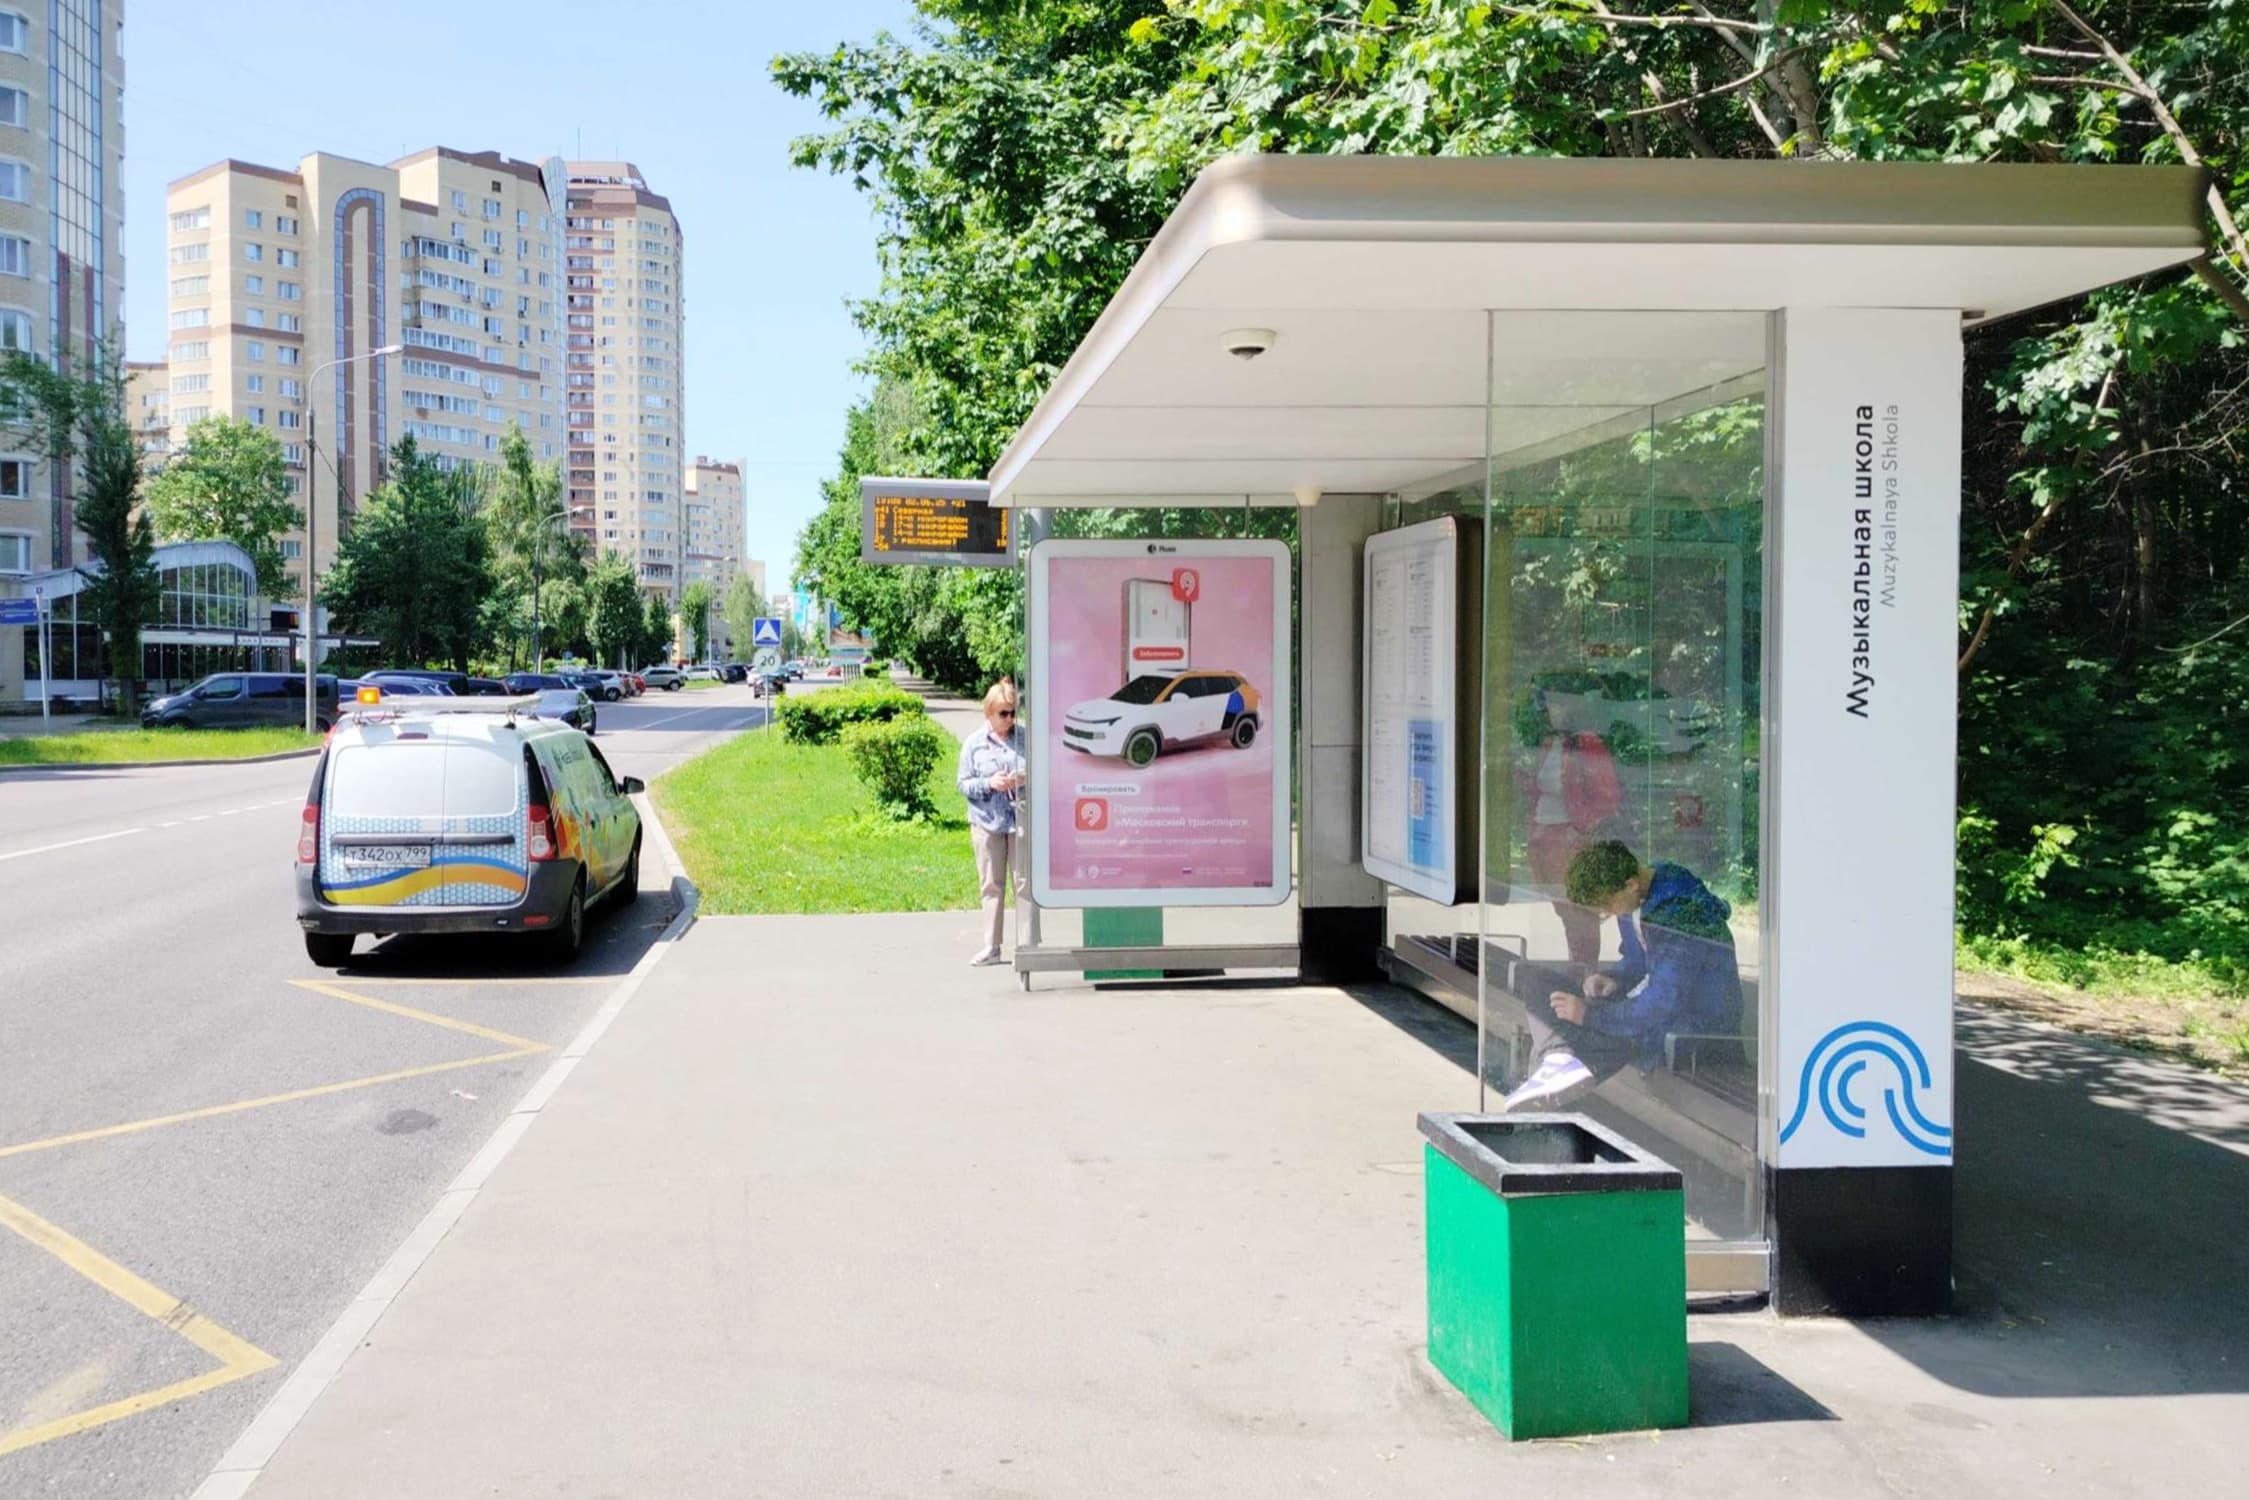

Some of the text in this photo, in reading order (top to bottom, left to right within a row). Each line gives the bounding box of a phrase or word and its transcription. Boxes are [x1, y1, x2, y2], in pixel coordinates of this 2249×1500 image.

[1880, 404, 1900, 608] Muzykalnaya Shkola
[1846, 404, 1874, 718] Музыкальная школа
[761, 655, 775, 666] 20
[1081, 785, 1136, 795] Бронировать
[406, 847, 427, 857] 799
